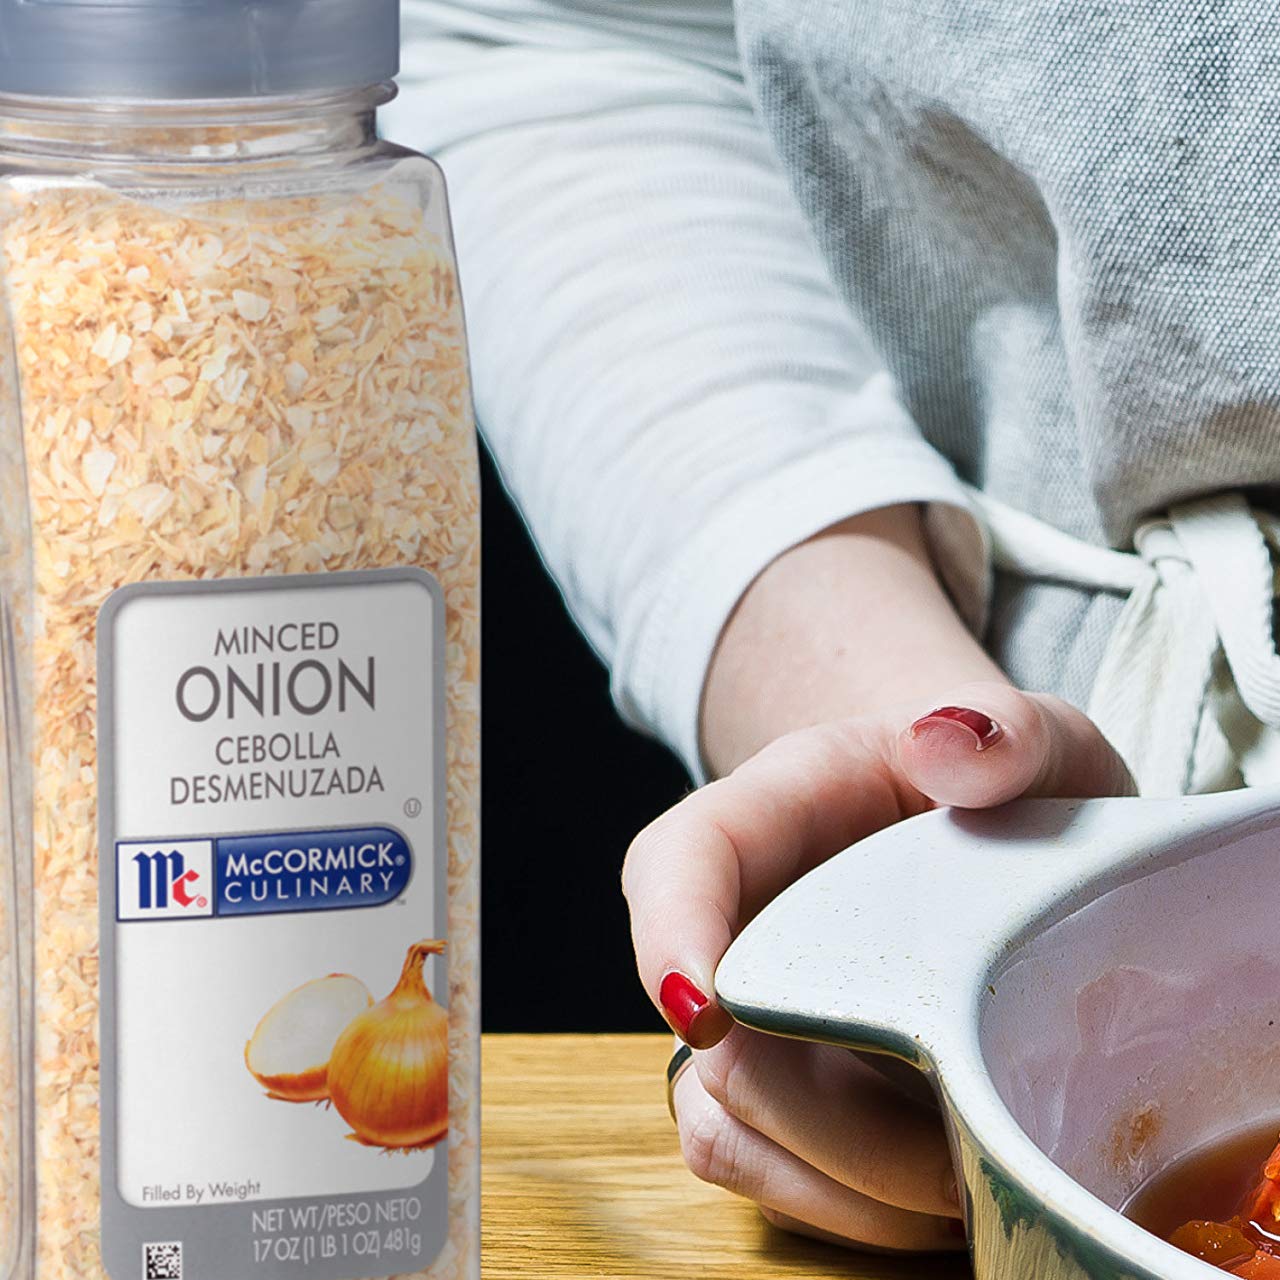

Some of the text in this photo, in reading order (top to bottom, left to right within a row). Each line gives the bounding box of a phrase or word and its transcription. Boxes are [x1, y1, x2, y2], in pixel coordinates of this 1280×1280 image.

[214, 622, 339, 656] MINCED
[176, 656, 375, 722] ONION
[215, 731, 340, 765] CEBOLLA
[171, 766, 385, 805] DESMENUZADA
[224, 871, 394, 903] CULINARY
[142, 1179, 261, 1203] Filled By Weight
[252, 1197, 422, 1233] NET WT/PESO NETO
[253, 1239, 272, 1262] 17
[274, 1237, 300, 1261] OZ
[321, 1234, 337, 1258] LB
[342, 1233, 348, 1256] 1
[383, 1227, 422, 1256] 481g
